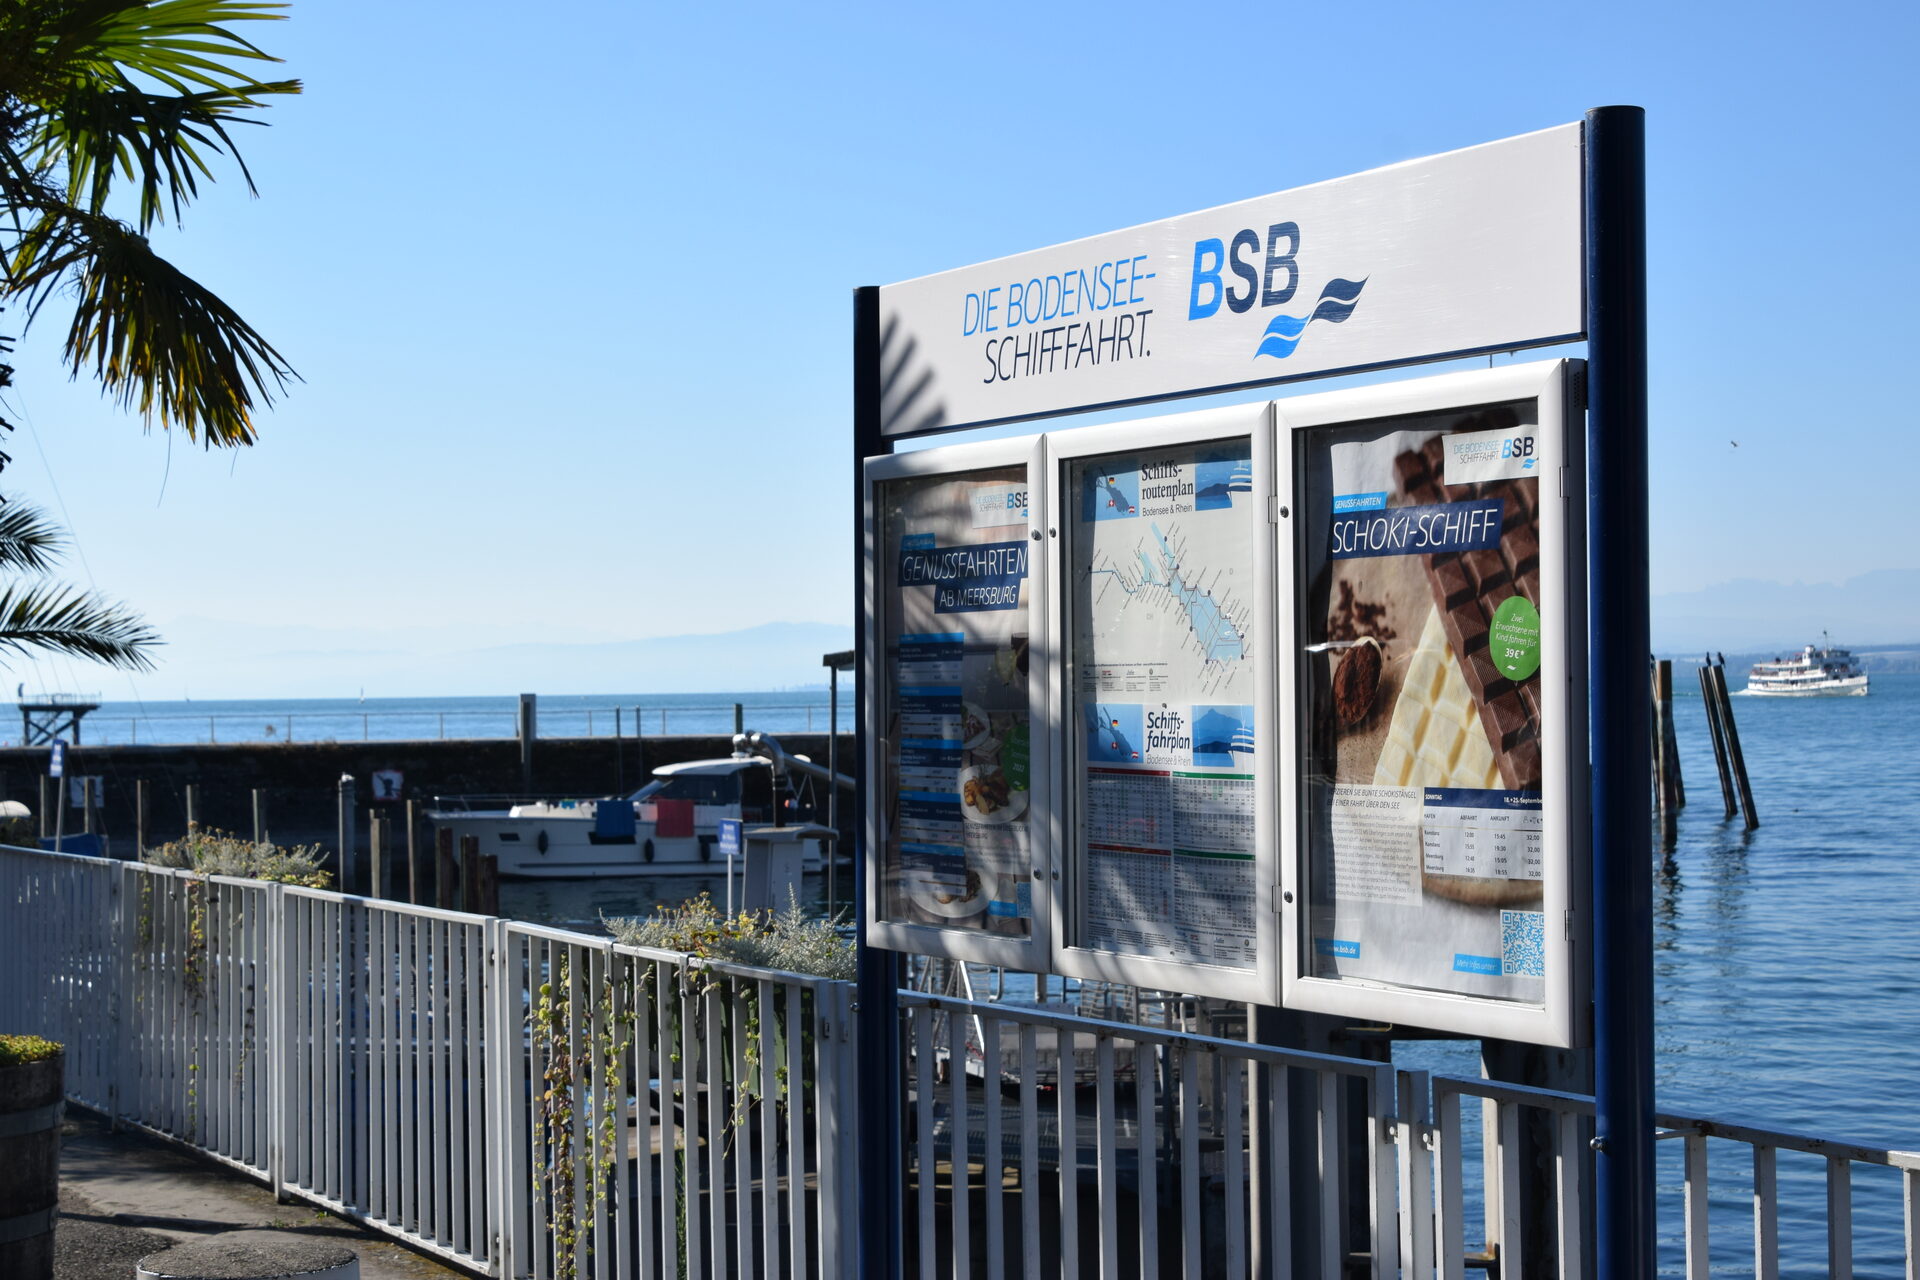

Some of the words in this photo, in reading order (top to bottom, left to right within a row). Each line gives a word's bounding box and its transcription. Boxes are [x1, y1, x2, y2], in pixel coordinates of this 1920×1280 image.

[1188, 221, 1301, 321] BSB
[963, 287, 1002, 337] DIE
[1007, 255, 1156, 328] BODENSEE-
[983, 309, 1154, 384] SCHIFFFAHRT.
[1501, 436, 1534, 459] BSB
[1141, 459, 1182, 481] Schiffs-
[1141, 478, 1194, 501] routenplan
[1142, 507, 1169, 517] Bodensee
[1176, 503, 1193, 513] Rhein
[1335, 496, 1382, 509] GENUSSFAHRTEN
[1332, 508, 1498, 553] SCHOKI-SCHIFF
[902, 547, 1028, 581] GENUSSFAHRTEN
[939, 589, 954, 607] AB
[956, 585, 1017, 607] MEERSBURG
[1495, 632, 1508, 642] Kind
[1146, 711, 1185, 735] Schiffs-
[1145, 730, 1190, 754] fahrplan
[1349, 800, 1365, 808] FAHRT
[1365, 799, 1379, 809] ÜBER
[1379, 801, 1390, 809] DEN
[1390, 801, 1400, 810] SEE
[1528, 870, 1541, 878] 32,00
